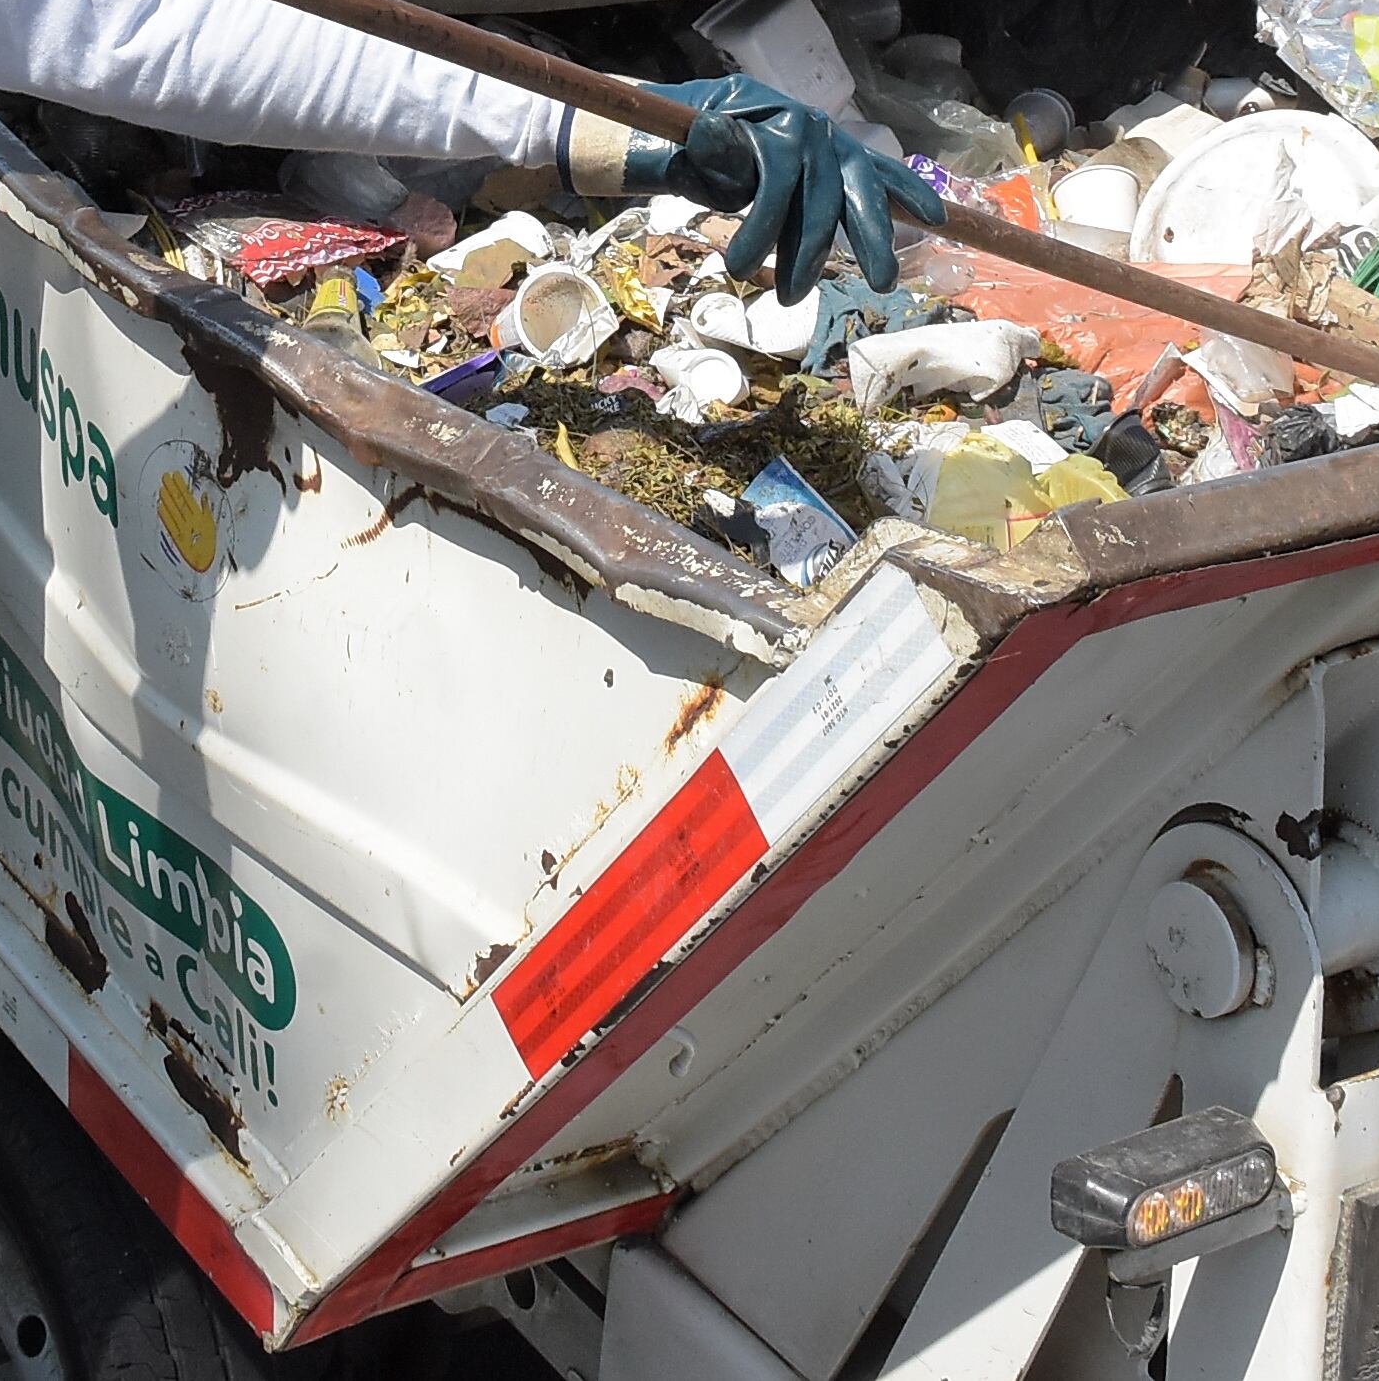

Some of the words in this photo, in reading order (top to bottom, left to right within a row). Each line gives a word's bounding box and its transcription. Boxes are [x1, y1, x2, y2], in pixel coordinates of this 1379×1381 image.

[1, 766, 133, 959] cumple
[144, 941, 165, 981] a
[176, 950, 280, 1108] Cali!
[95, 798, 277, 1005] Limpia
